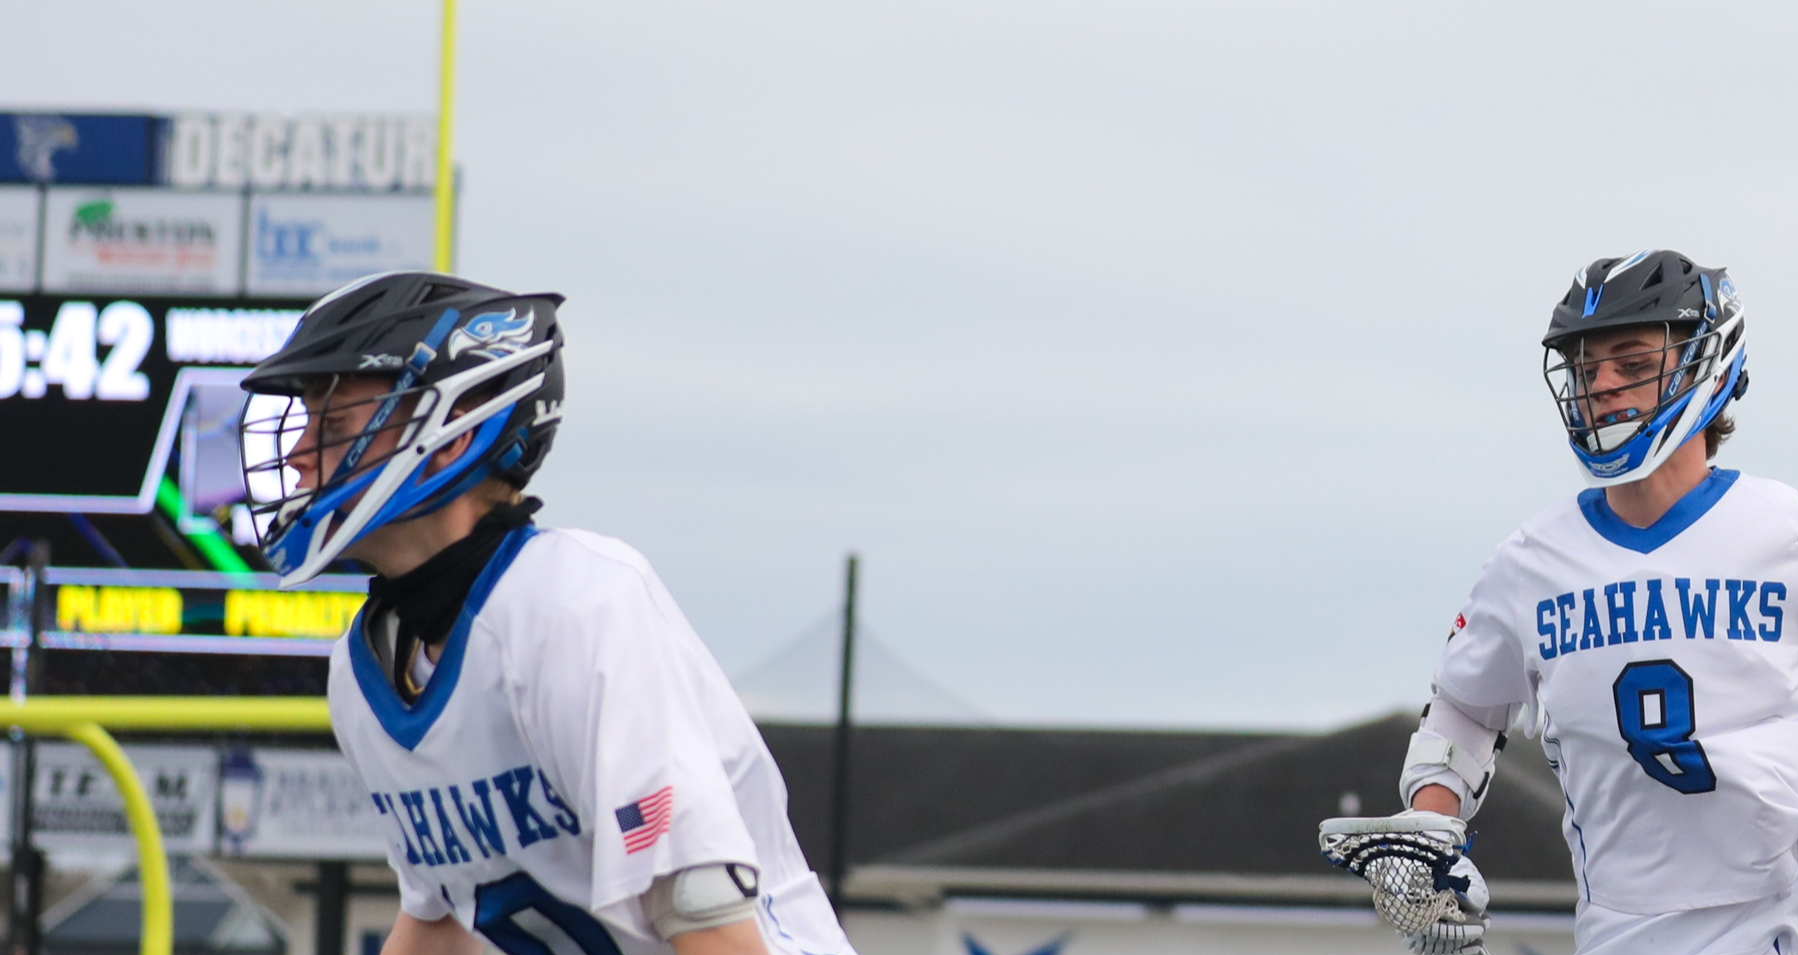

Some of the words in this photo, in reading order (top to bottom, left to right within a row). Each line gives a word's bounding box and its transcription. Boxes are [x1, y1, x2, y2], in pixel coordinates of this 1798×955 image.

[172, 114, 437, 187] DECATUR
[1537, 577, 1787, 661] SEAHAWKS
[1612, 658, 1717, 795] 8
